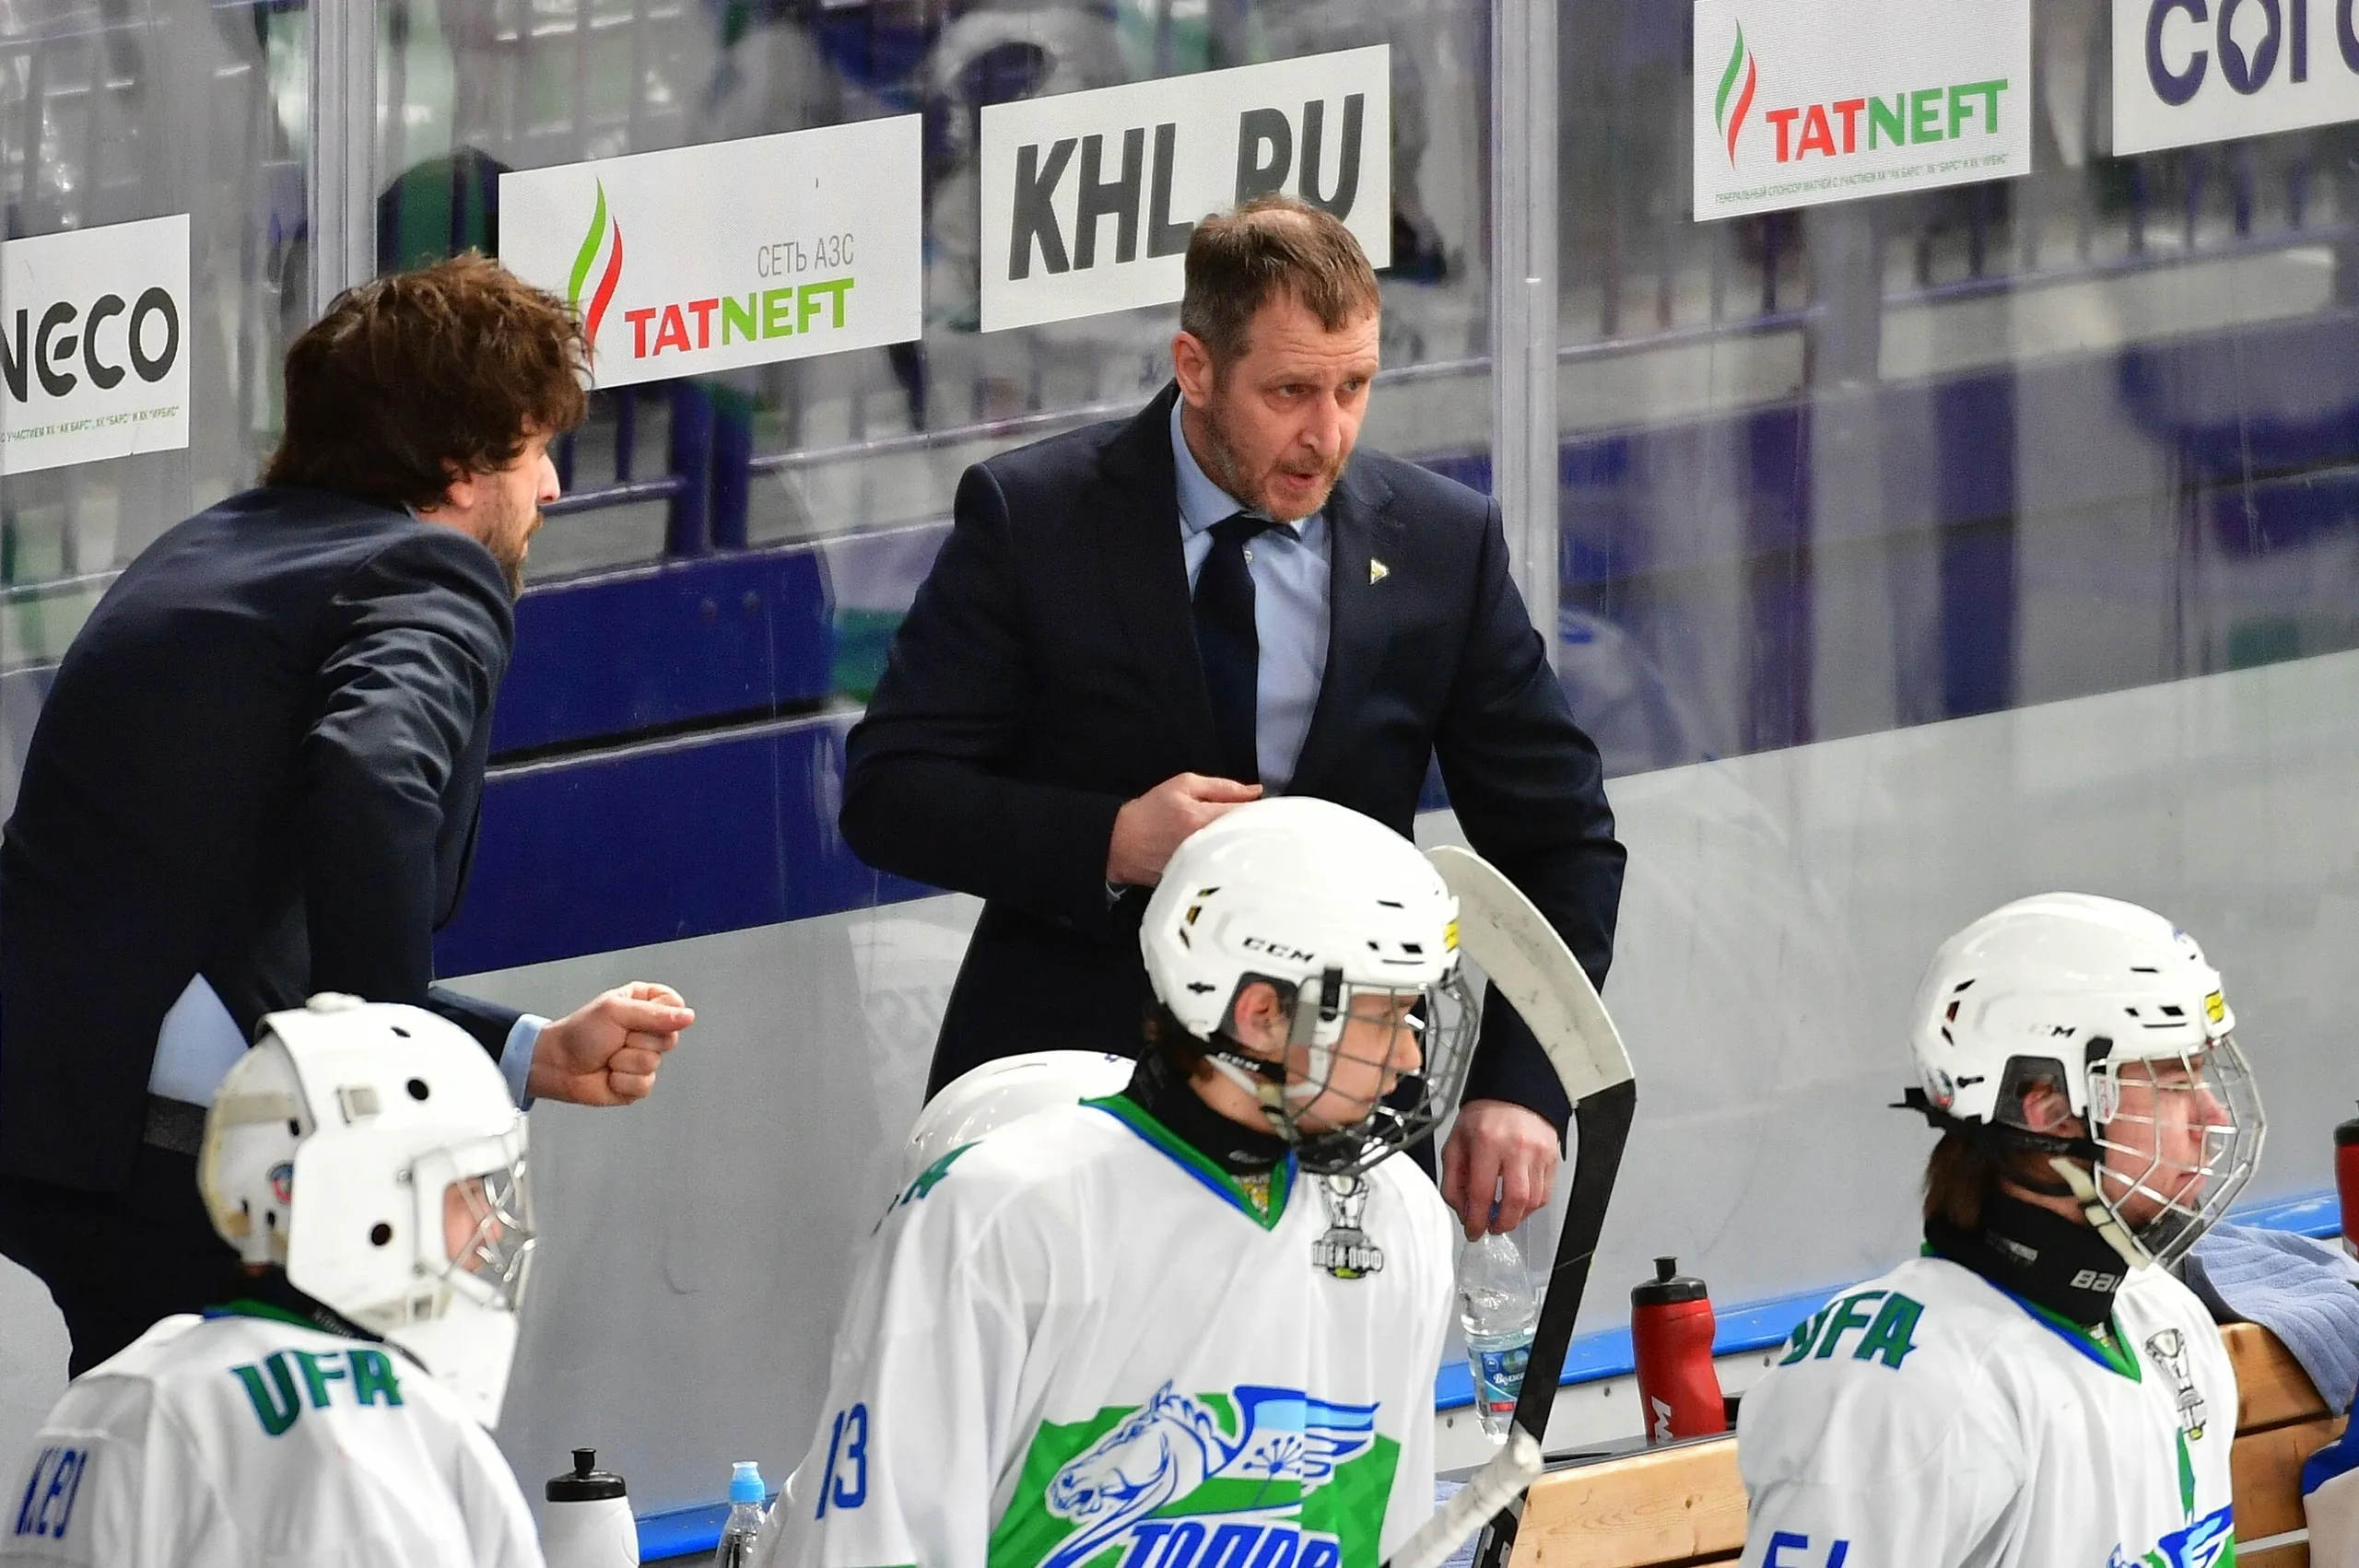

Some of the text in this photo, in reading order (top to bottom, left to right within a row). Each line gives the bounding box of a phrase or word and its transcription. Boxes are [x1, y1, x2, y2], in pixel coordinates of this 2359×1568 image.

[1765, 77, 2009, 164] TATNEFT
[757, 233, 854, 278] СЕТЬ АЗС
[624, 276, 855, 360] TATNEFT
[1242, 936, 1315, 964] CCM
[229, 1348, 404, 1437] UFA
[815, 1402, 868, 1521] 13
